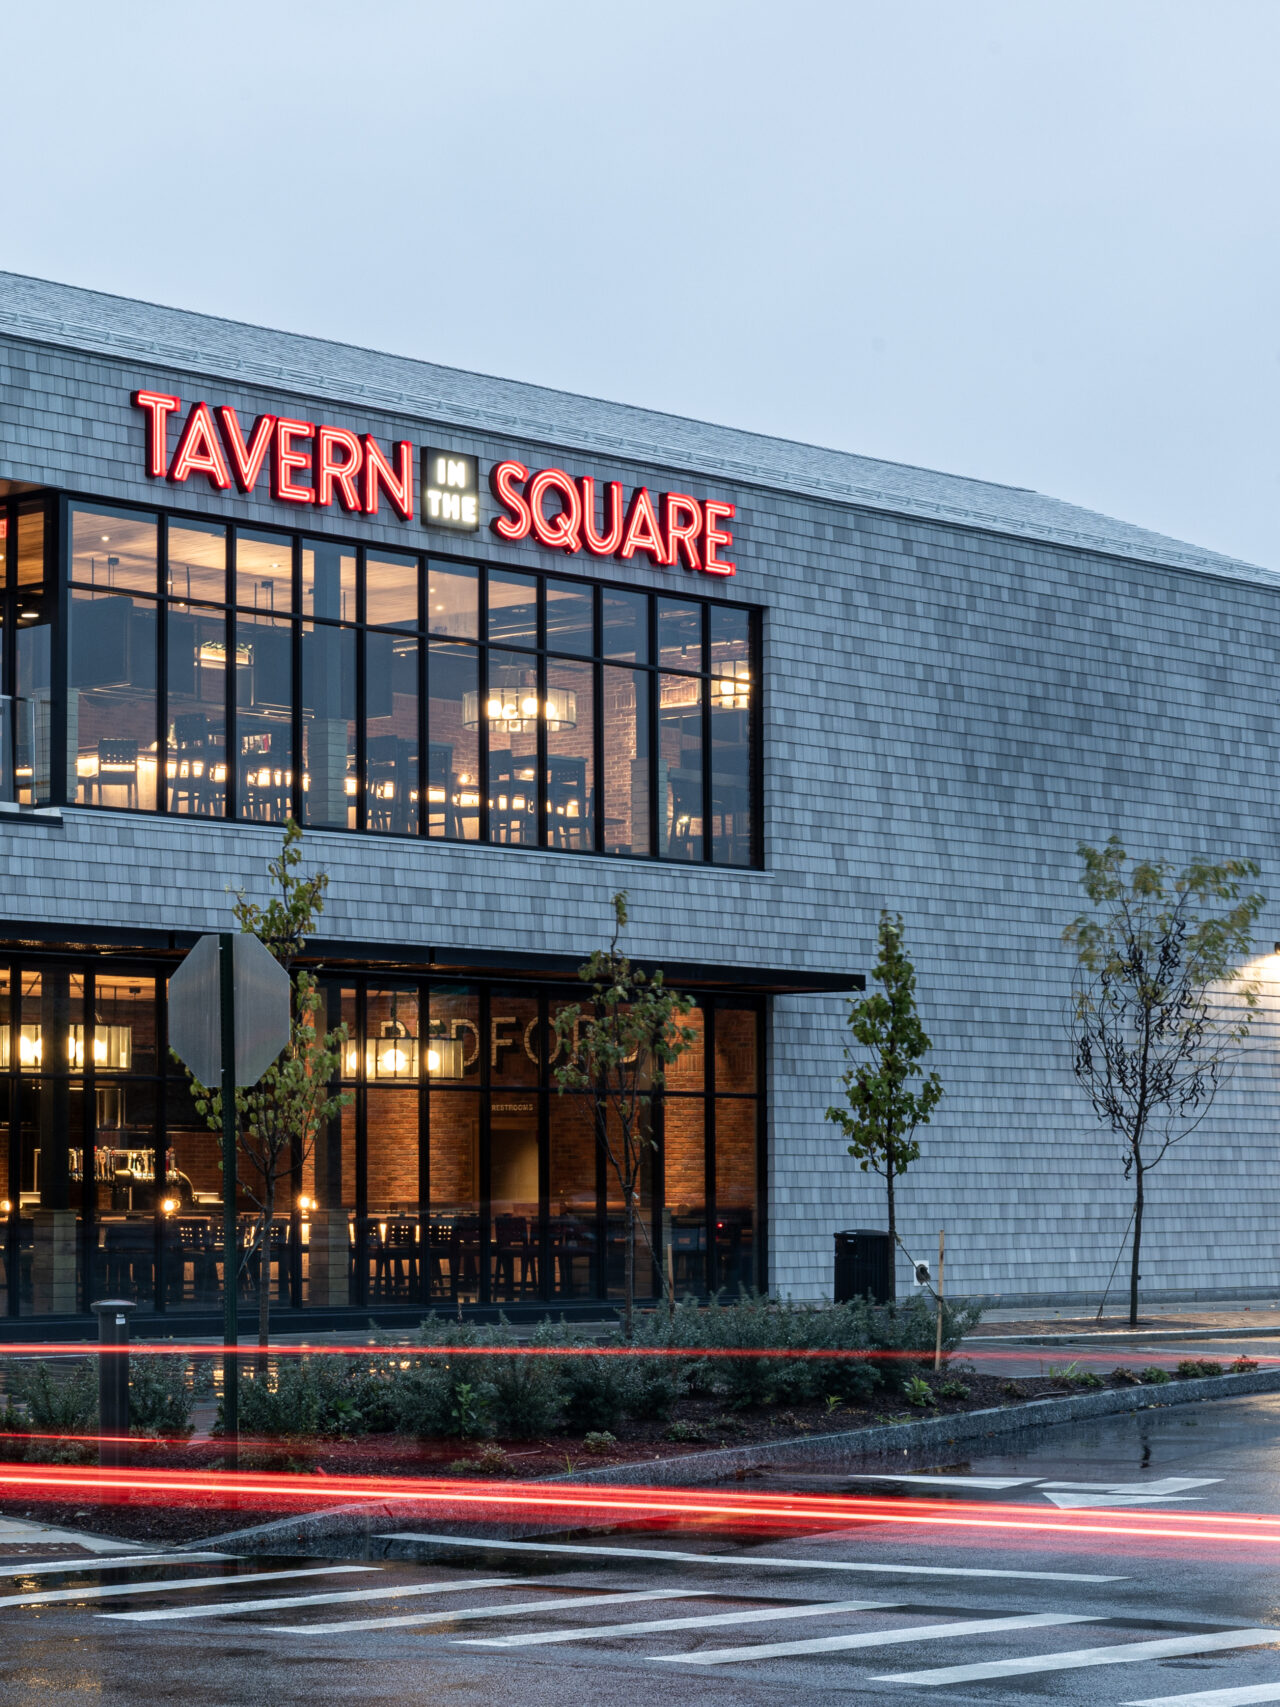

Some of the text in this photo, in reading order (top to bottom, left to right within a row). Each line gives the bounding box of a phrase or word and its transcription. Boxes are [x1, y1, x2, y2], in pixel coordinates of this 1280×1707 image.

[131, 389, 414, 522] TAVERN
[436, 457, 466, 489] IN
[427, 489, 477, 523] THE
[489, 459, 737, 578] SQUARE
[491, 1104, 534, 1112] RESTROOMS
